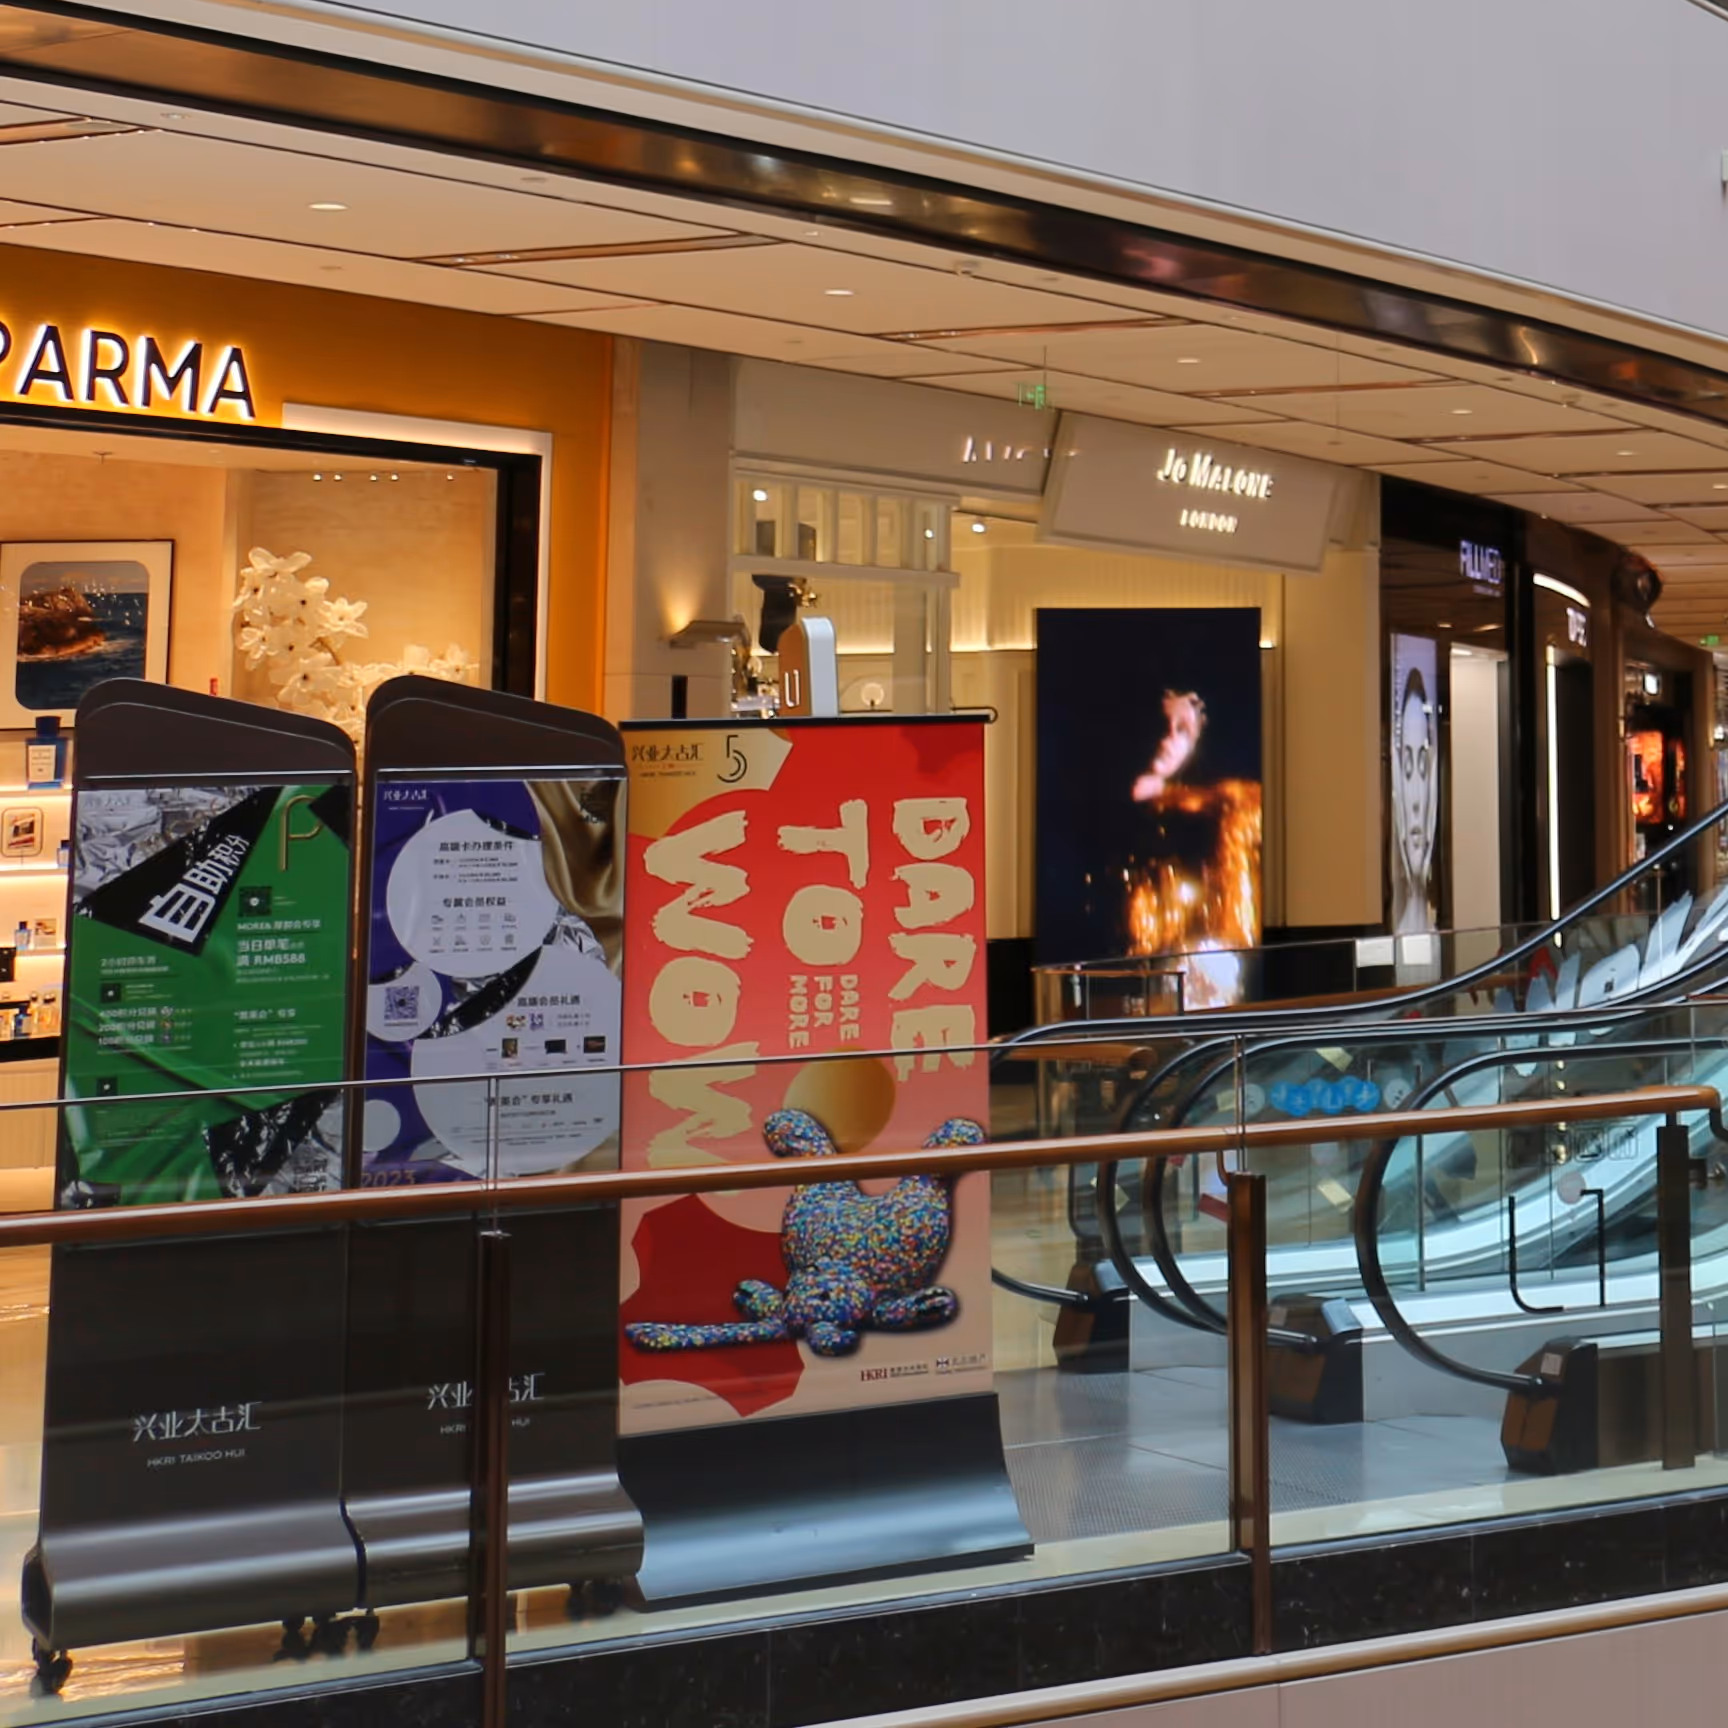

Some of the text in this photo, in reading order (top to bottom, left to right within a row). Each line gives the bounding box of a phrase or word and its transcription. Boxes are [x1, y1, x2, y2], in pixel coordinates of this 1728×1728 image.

[776, 799, 870, 966] TO
[888, 797, 977, 1082] DARE
[788, 974, 810, 1050] MORE
[813, 975, 834, 1028] FOR
[839, 974, 860, 1041] DARE
